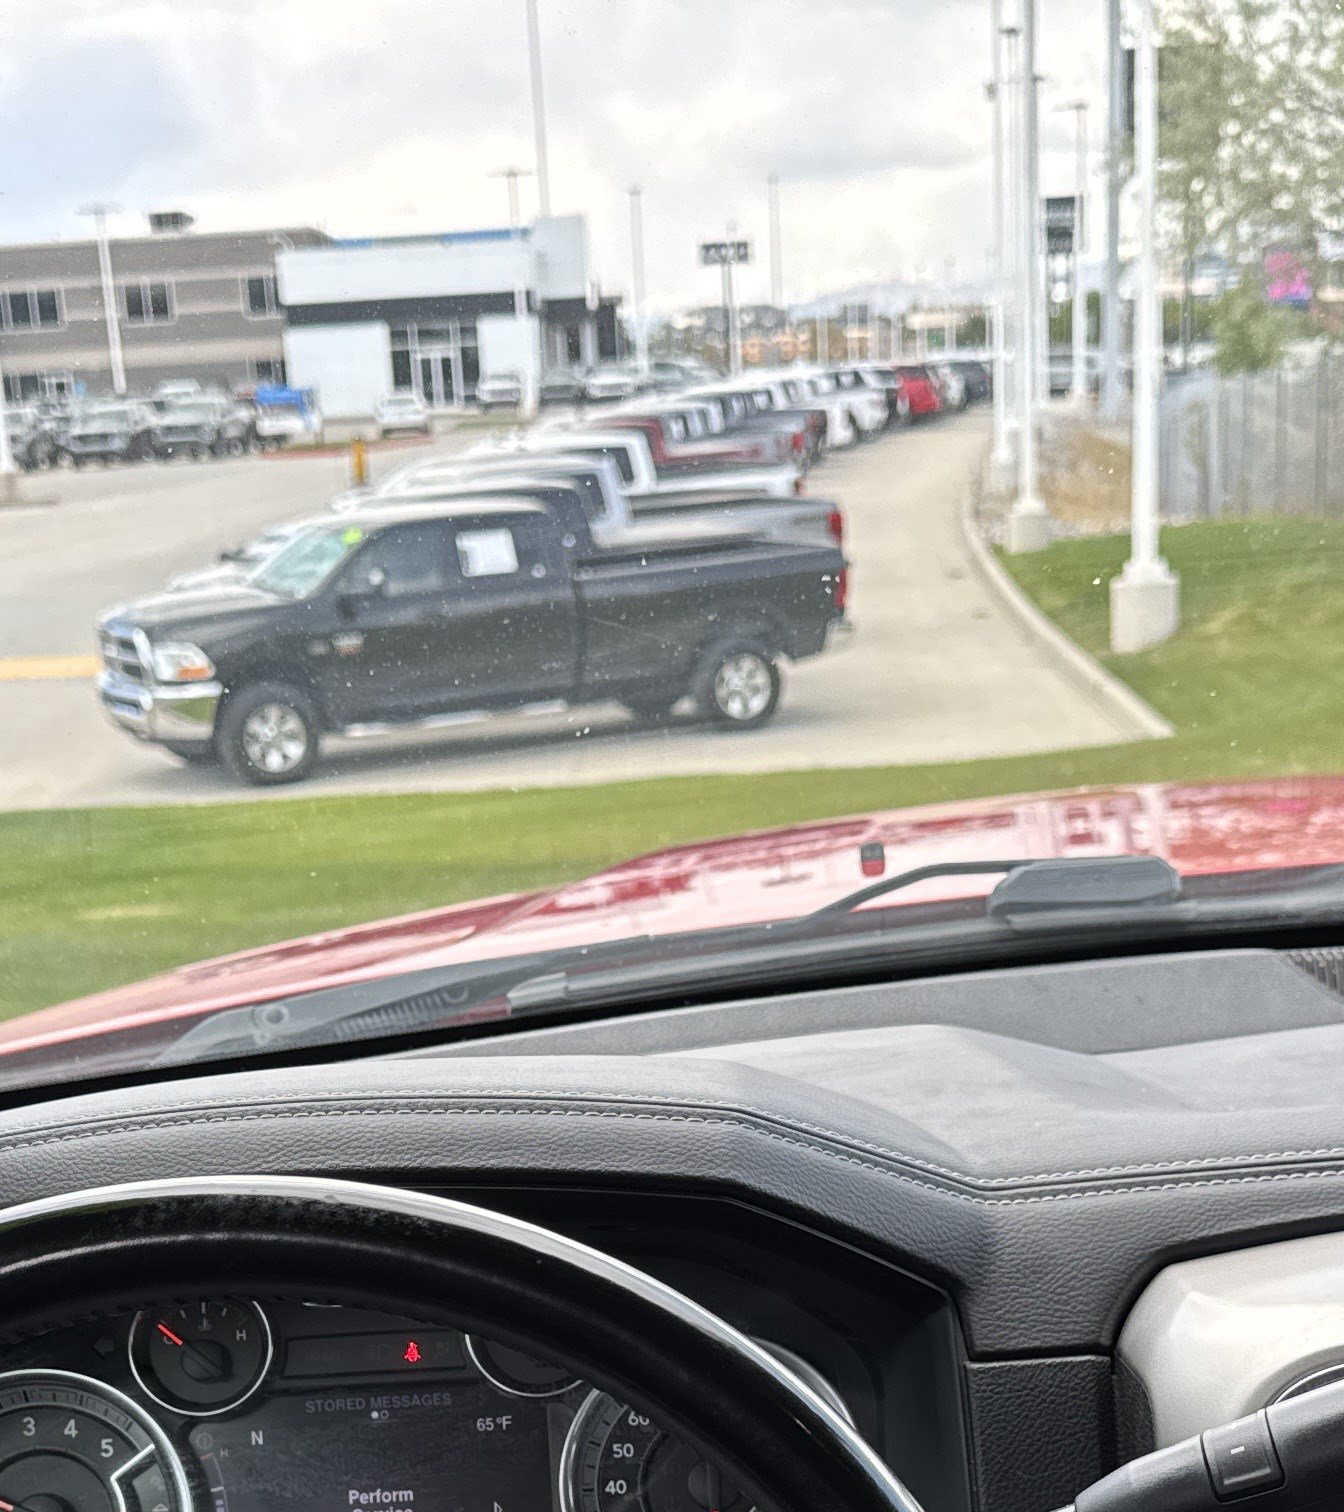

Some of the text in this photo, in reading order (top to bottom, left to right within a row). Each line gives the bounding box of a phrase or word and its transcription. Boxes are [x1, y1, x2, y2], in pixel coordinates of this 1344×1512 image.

[236, 1329, 247, 1342] H
[305, 1392, 453, 1414] STORED MESSAGES
[22, 1416, 36, 1437] 3
[63, 1418, 79, 1439] 4
[250, 1429, 264, 1446] N
[100, 1438, 114, 1458] 5
[612, 1443, 635, 1459] 50
[605, 1479, 627, 1495] 40
[348, 1488, 414, 1505] Perform
